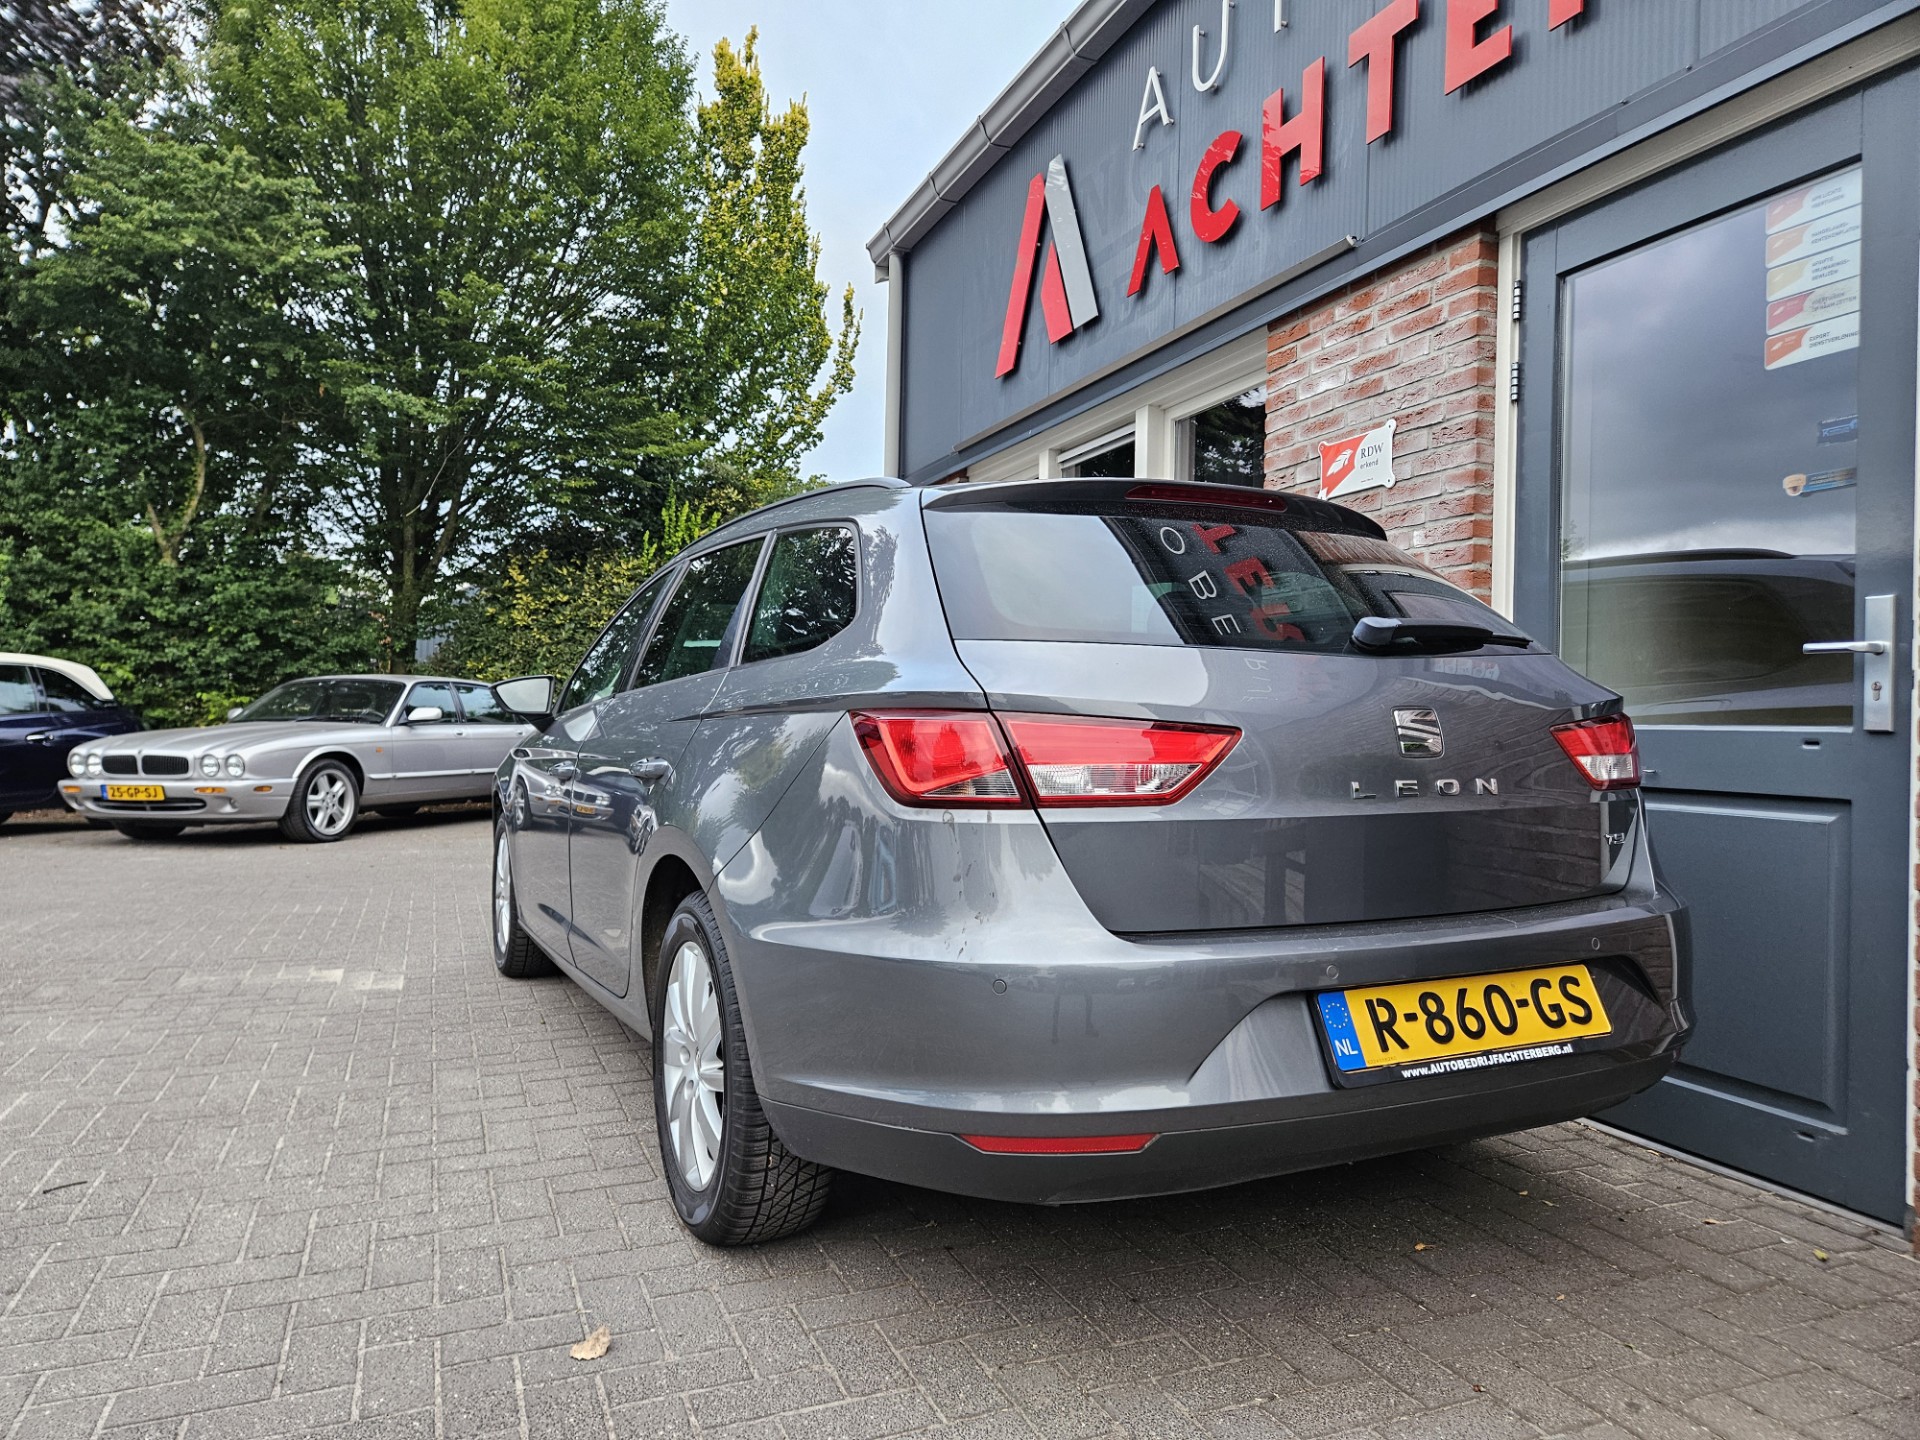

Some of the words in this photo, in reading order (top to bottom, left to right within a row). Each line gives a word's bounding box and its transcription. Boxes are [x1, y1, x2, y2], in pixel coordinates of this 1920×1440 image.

[1132, 0, 1286, 151] AU
[1126, 0, 1583, 298] ACHTE
[1360, 442, 1384, 459] RDW
[1359, 459, 1379, 470] erkend
[109, 786, 158, 799] 25-GP-SJ
[1350, 777, 1499, 800] LEON
[1365, 974, 1593, 1053] R-860-GS
[1334, 1038, 1359, 1058] NL
[1401, 1043, 1574, 1079] www.AUTOBEDRIJFACHTERBERG.nl
